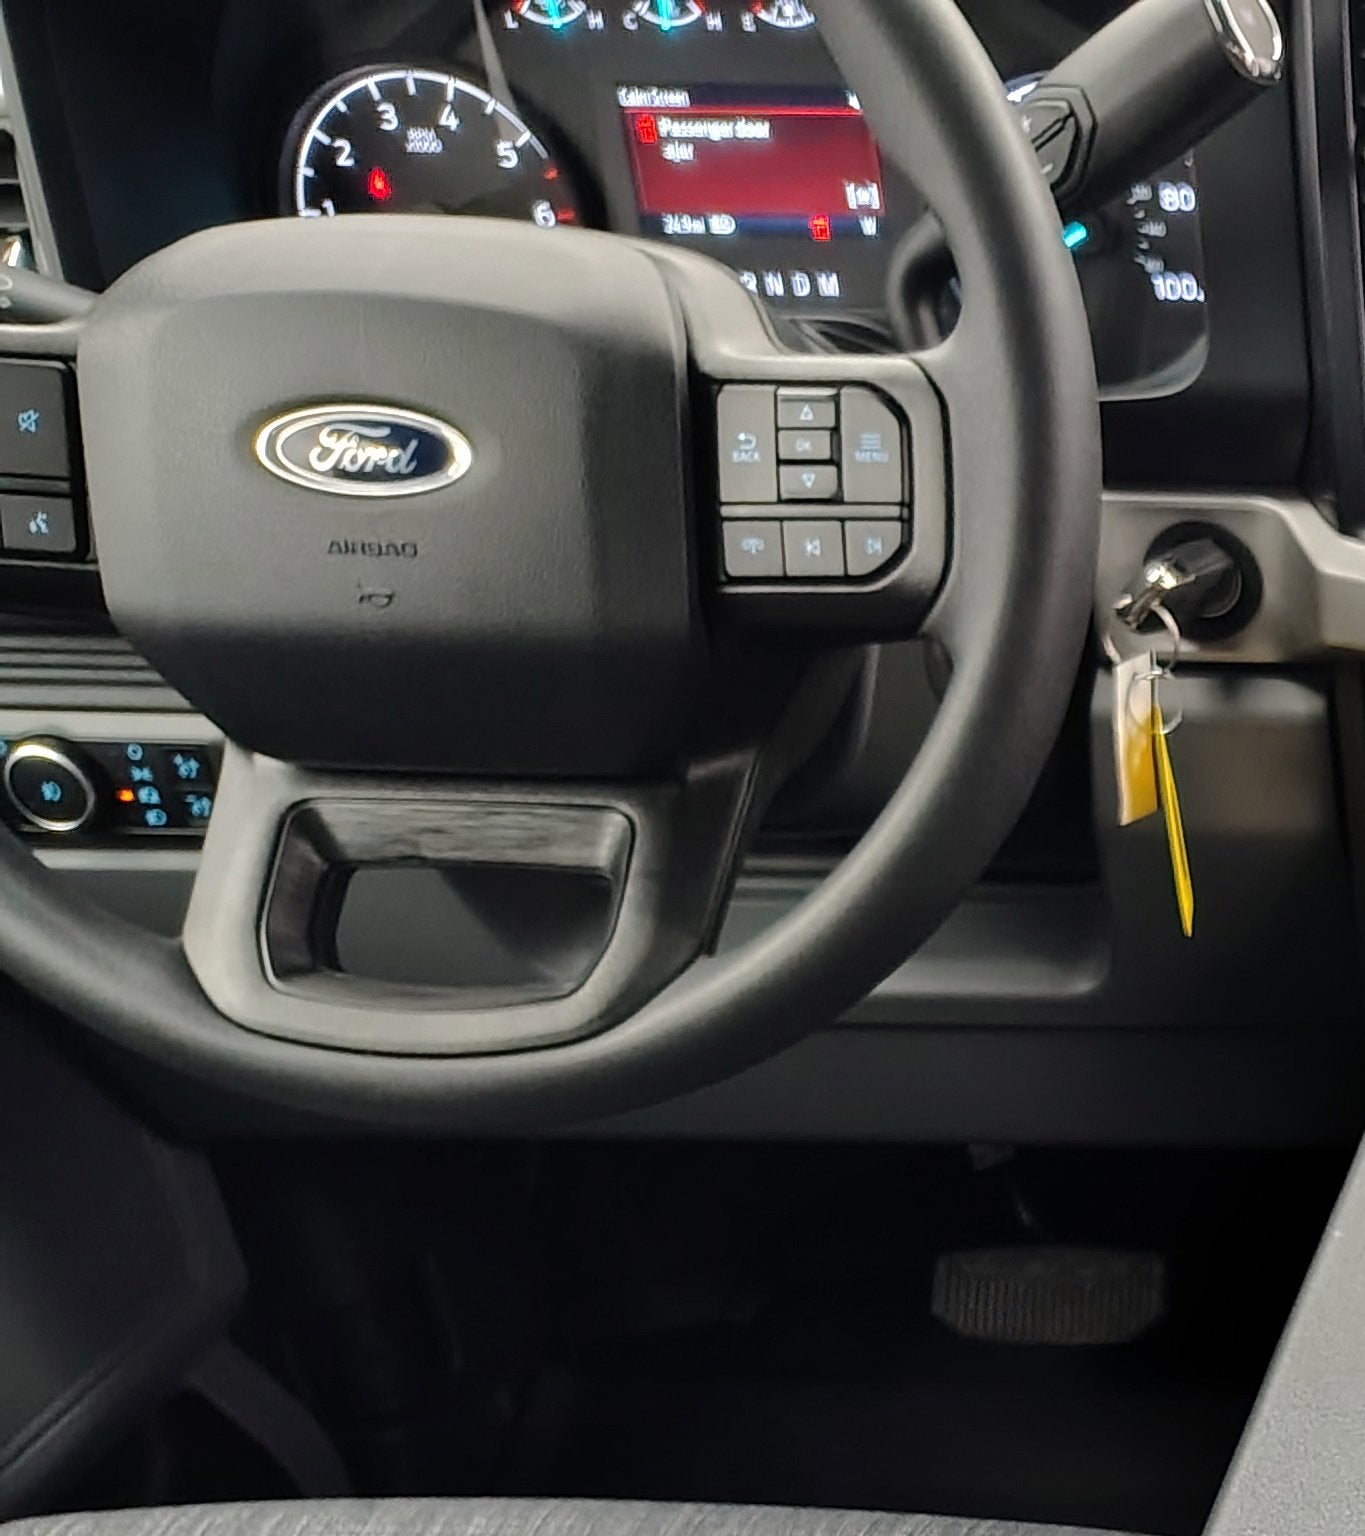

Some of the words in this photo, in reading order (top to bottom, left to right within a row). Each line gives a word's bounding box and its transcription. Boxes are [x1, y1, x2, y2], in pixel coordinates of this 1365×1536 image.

[377, 102, 398, 131] 3
[439, 105, 460, 132] 4
[332, 139, 355, 167] 2
[497, 141, 519, 169] 5
[320, 198, 336, 218] 1
[532, 199, 557, 228] 6
[763, 271, 784, 297] N
[790, 271, 811, 297] D
[309, 422, 420, 476] Ford
